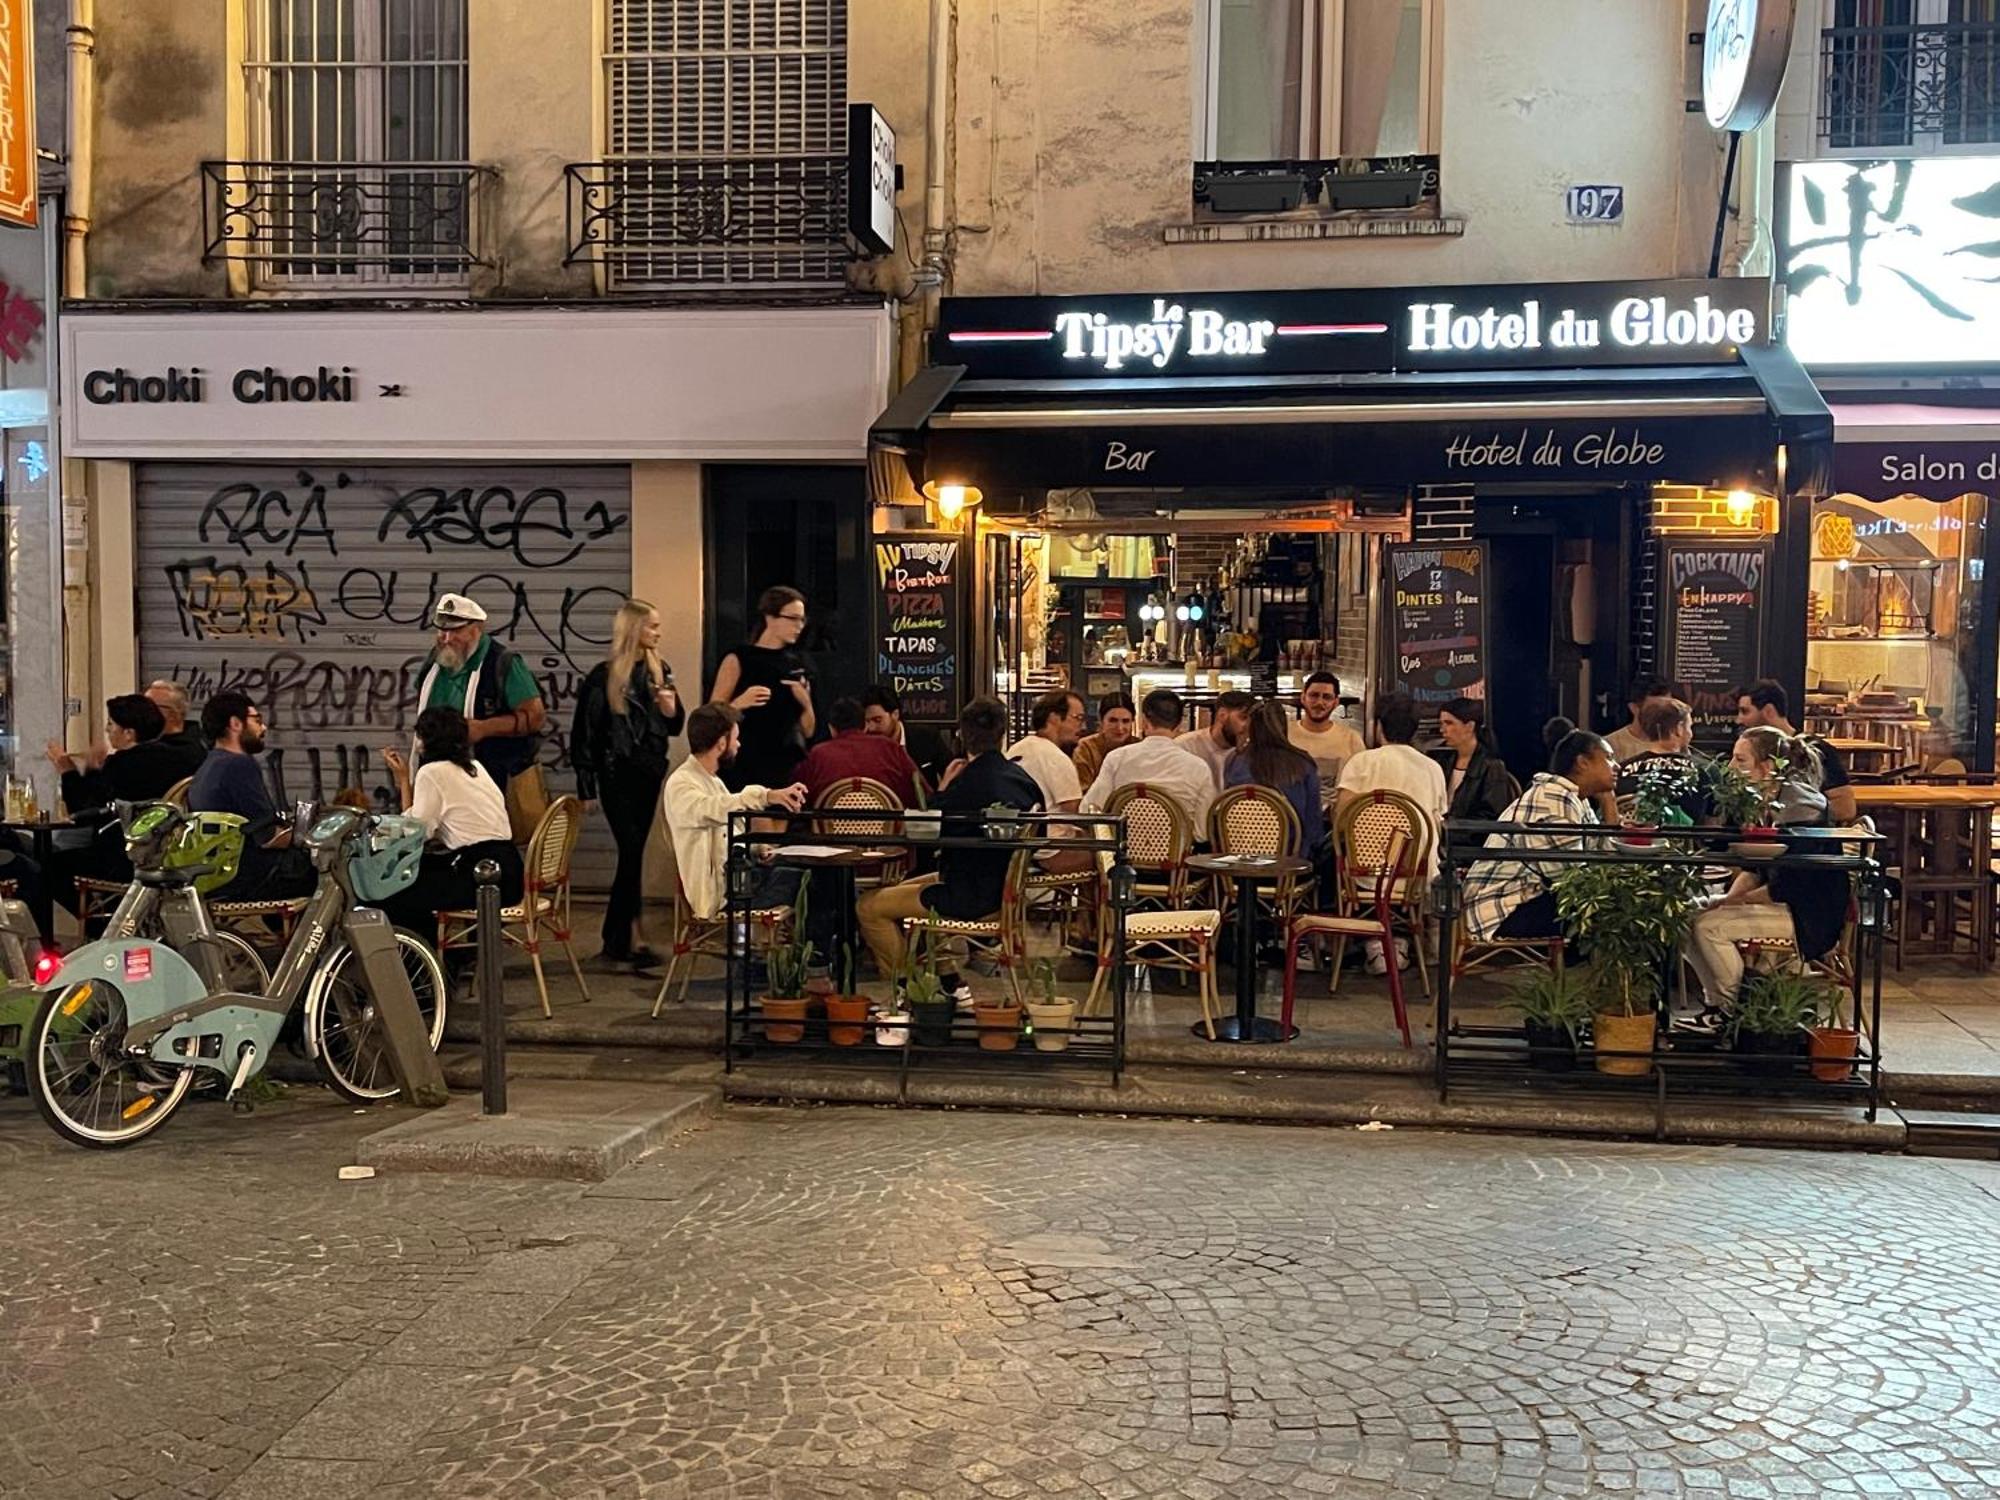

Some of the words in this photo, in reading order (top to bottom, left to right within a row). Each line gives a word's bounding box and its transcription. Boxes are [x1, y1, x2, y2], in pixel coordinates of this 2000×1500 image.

[1569, 187, 1622, 220] 197
[1153, 299, 1183, 321] Le
[1056, 311, 1183, 369] Tipsy
[1188, 310, 1275, 356] Bar
[1407, 300, 1542, 351] Hotel
[1549, 309, 1600, 348] du
[1609, 295, 1755, 347] Globe
[84, 367, 202, 405] Choki
[232, 366, 352, 404] Choki
[1104, 441, 1156, 472] Bar
[1445, 429, 1526, 468] Hotel
[1532, 429, 1562, 466] du
[1572, 428, 1665, 468] Globe
[1881, 453, 1965, 481] Salon
[1976, 452, 2000, 481] d
[900, 542, 959, 574] TIPSY
[1393, 551, 1442, 581] HAPPY
[1671, 552, 1763, 590] COCKTAILS
[887, 593, 945, 615] PIZZA
[1396, 590, 1443, 606] PINTES
[885, 636, 936, 653] TAPAS
[879, 652, 955, 675] PLANCHES
